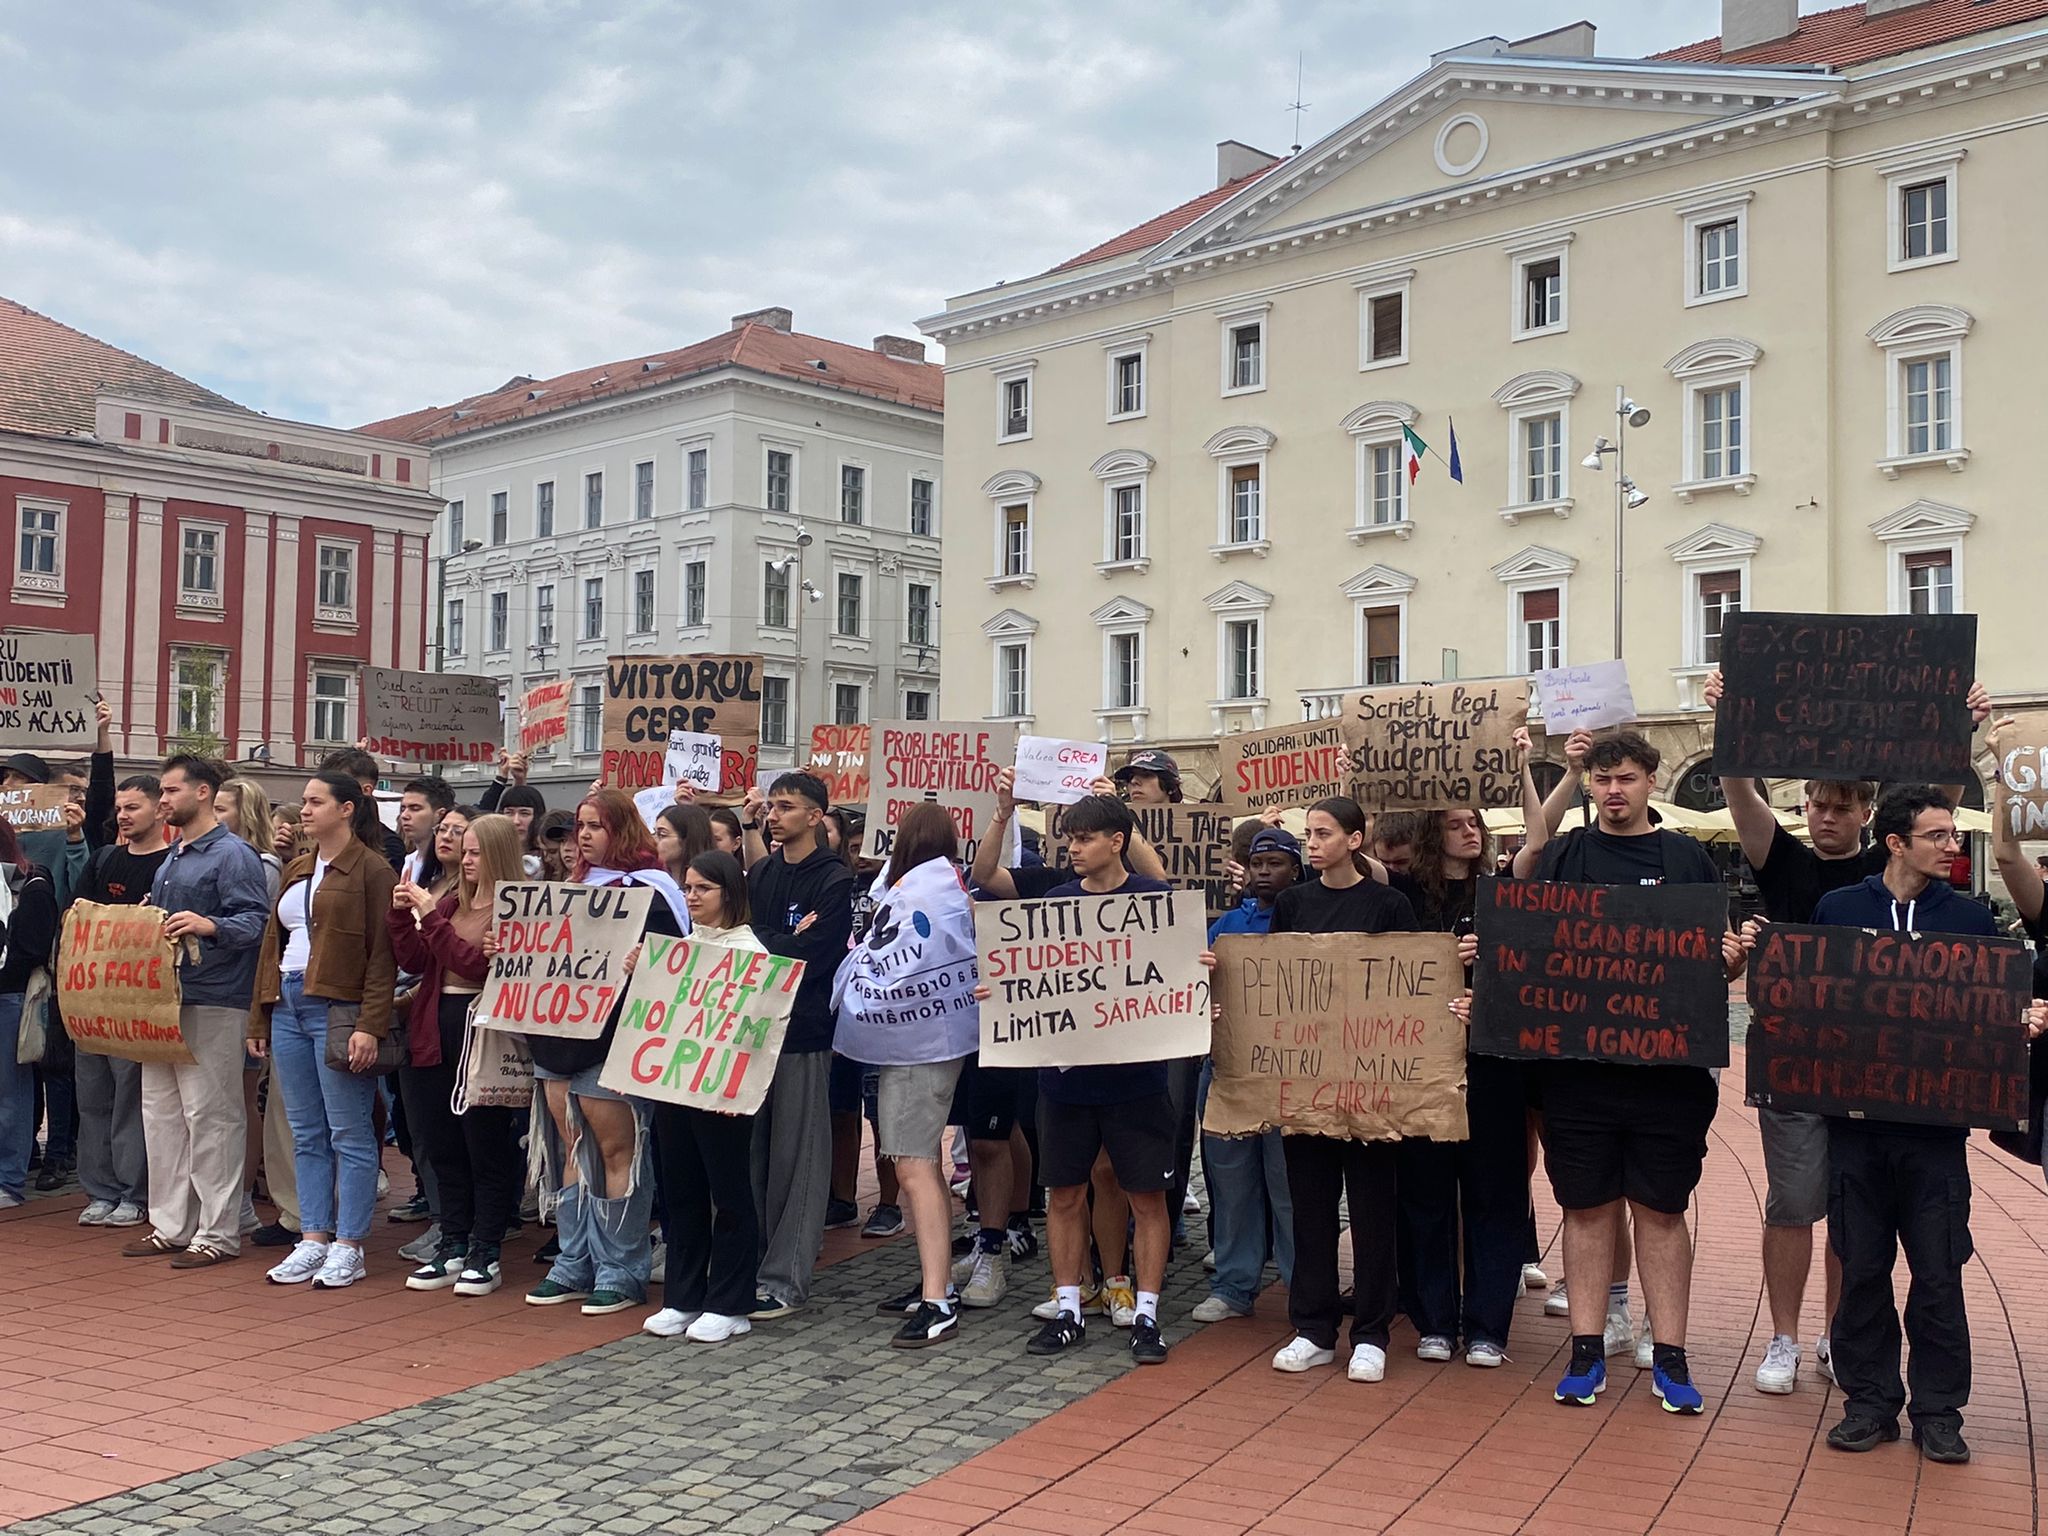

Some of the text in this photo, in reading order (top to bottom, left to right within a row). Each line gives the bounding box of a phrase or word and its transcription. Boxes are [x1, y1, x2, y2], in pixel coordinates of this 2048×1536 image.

[607, 661, 760, 703] VIITORUL
[28, 708, 87, 733] ACASĂ
[391, 695, 442, 714] TRECUT
[1452, 686, 1499, 726] legi
[811, 725, 871, 751] SCUZE
[883, 730, 990, 763] PROBLEMELE
[1242, 735, 1296, 758] SOLIDARI
[1387, 714, 1470, 744] pentru
[369, 736, 495, 762] DREPTURILOR
[811, 753, 832, 768] NU
[1058, 747, 1098, 764] GREA
[1352, 740, 1520, 780] studenți sau
[886, 756, 999, 793] STUDENȚILOR
[1061, 775, 1091, 789] GOL
[1349, 774, 1471, 811] împotriva
[1247, 795, 1264, 808] NU
[1266, 790, 1285, 806] POT
[1288, 789, 1299, 802] FI
[498, 884, 630, 920] STATUL
[1097, 892, 1175, 934] CÂȚI
[1495, 881, 1608, 918] MISIUNE
[497, 914, 574, 954] EDUCĂ
[65, 957, 163, 991] JOS FACE
[495, 951, 610, 980] DOAR DACĂ
[649, 937, 701, 976] VOI
[987, 935, 1132, 977] STUDENȚI
[1852, 936, 2021, 984] IGNORAT
[673, 976, 757, 1013] BUGET
[1000, 966, 1107, 1003] TRĂIESC
[1125, 961, 1164, 987] LA
[1243, 956, 1437, 1016] PENTRU TINE
[493, 983, 530, 1022] NU
[993, 980, 1210, 1043] LIMITA SĂRĂCIEI?
[1520, 985, 1660, 1019] CELUI CARE
[622, 999, 772, 1049] NOI AVEM
[1274, 1014, 1425, 1051] E UN NUMĂR
[1519, 1023, 1689, 1060] NE IGNORĂ
[631, 1037, 751, 1099] GRIJI
[1251, 1045, 1425, 1082] PENTRU MINE
[1280, 1080, 1392, 1119] E CHIRIA
